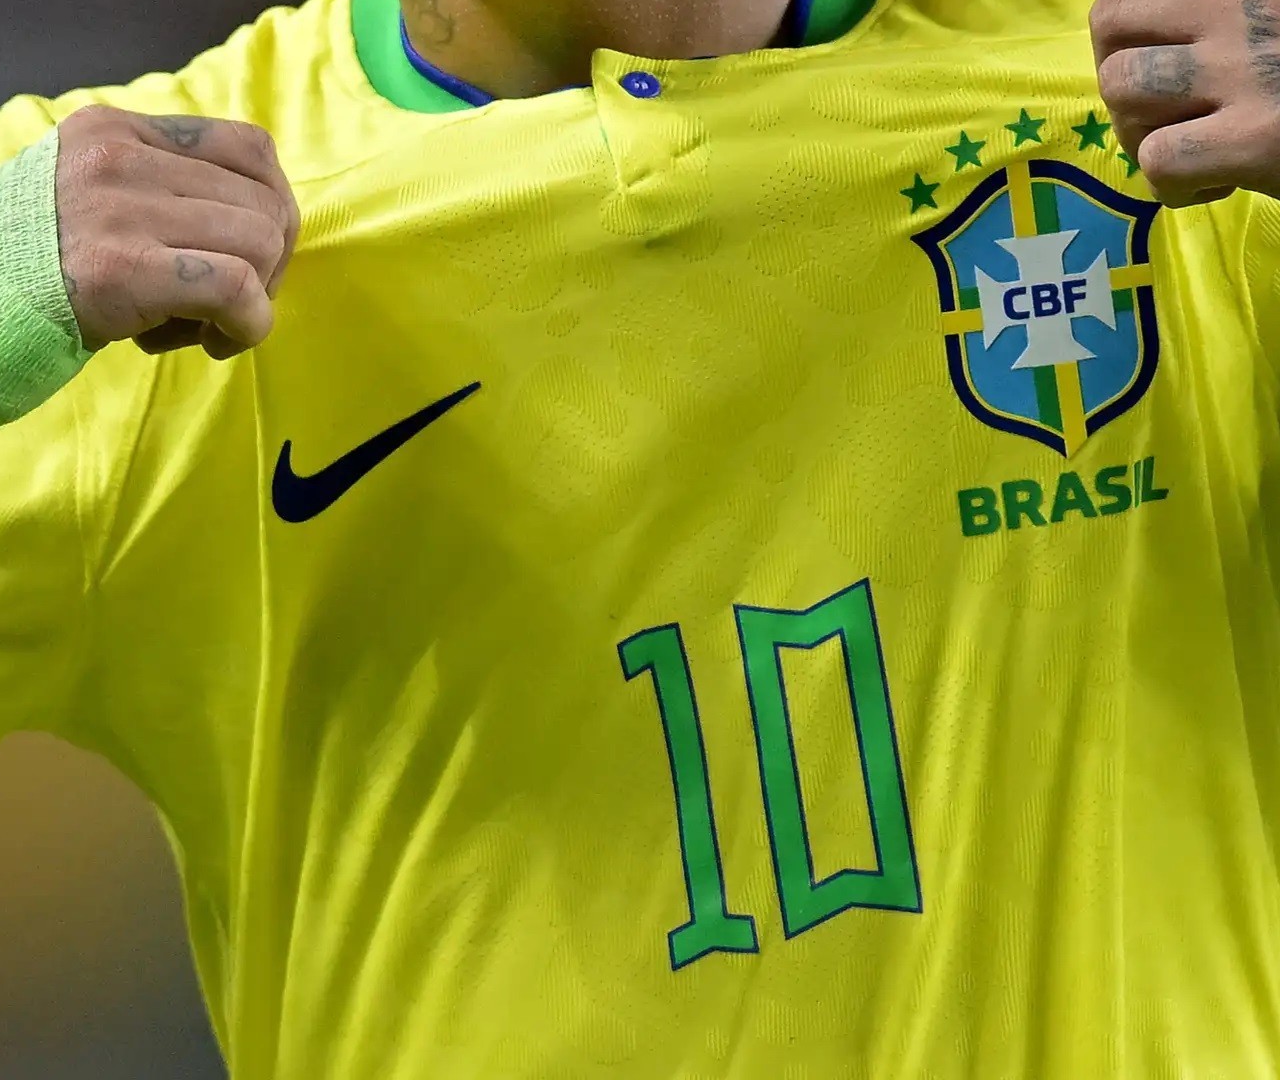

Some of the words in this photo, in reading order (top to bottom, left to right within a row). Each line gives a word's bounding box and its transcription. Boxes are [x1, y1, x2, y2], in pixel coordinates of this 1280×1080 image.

[1003, 278, 1087, 320] CBF
[957, 456, 1169, 537] BRASIL
[617, 577, 922, 971] 10
